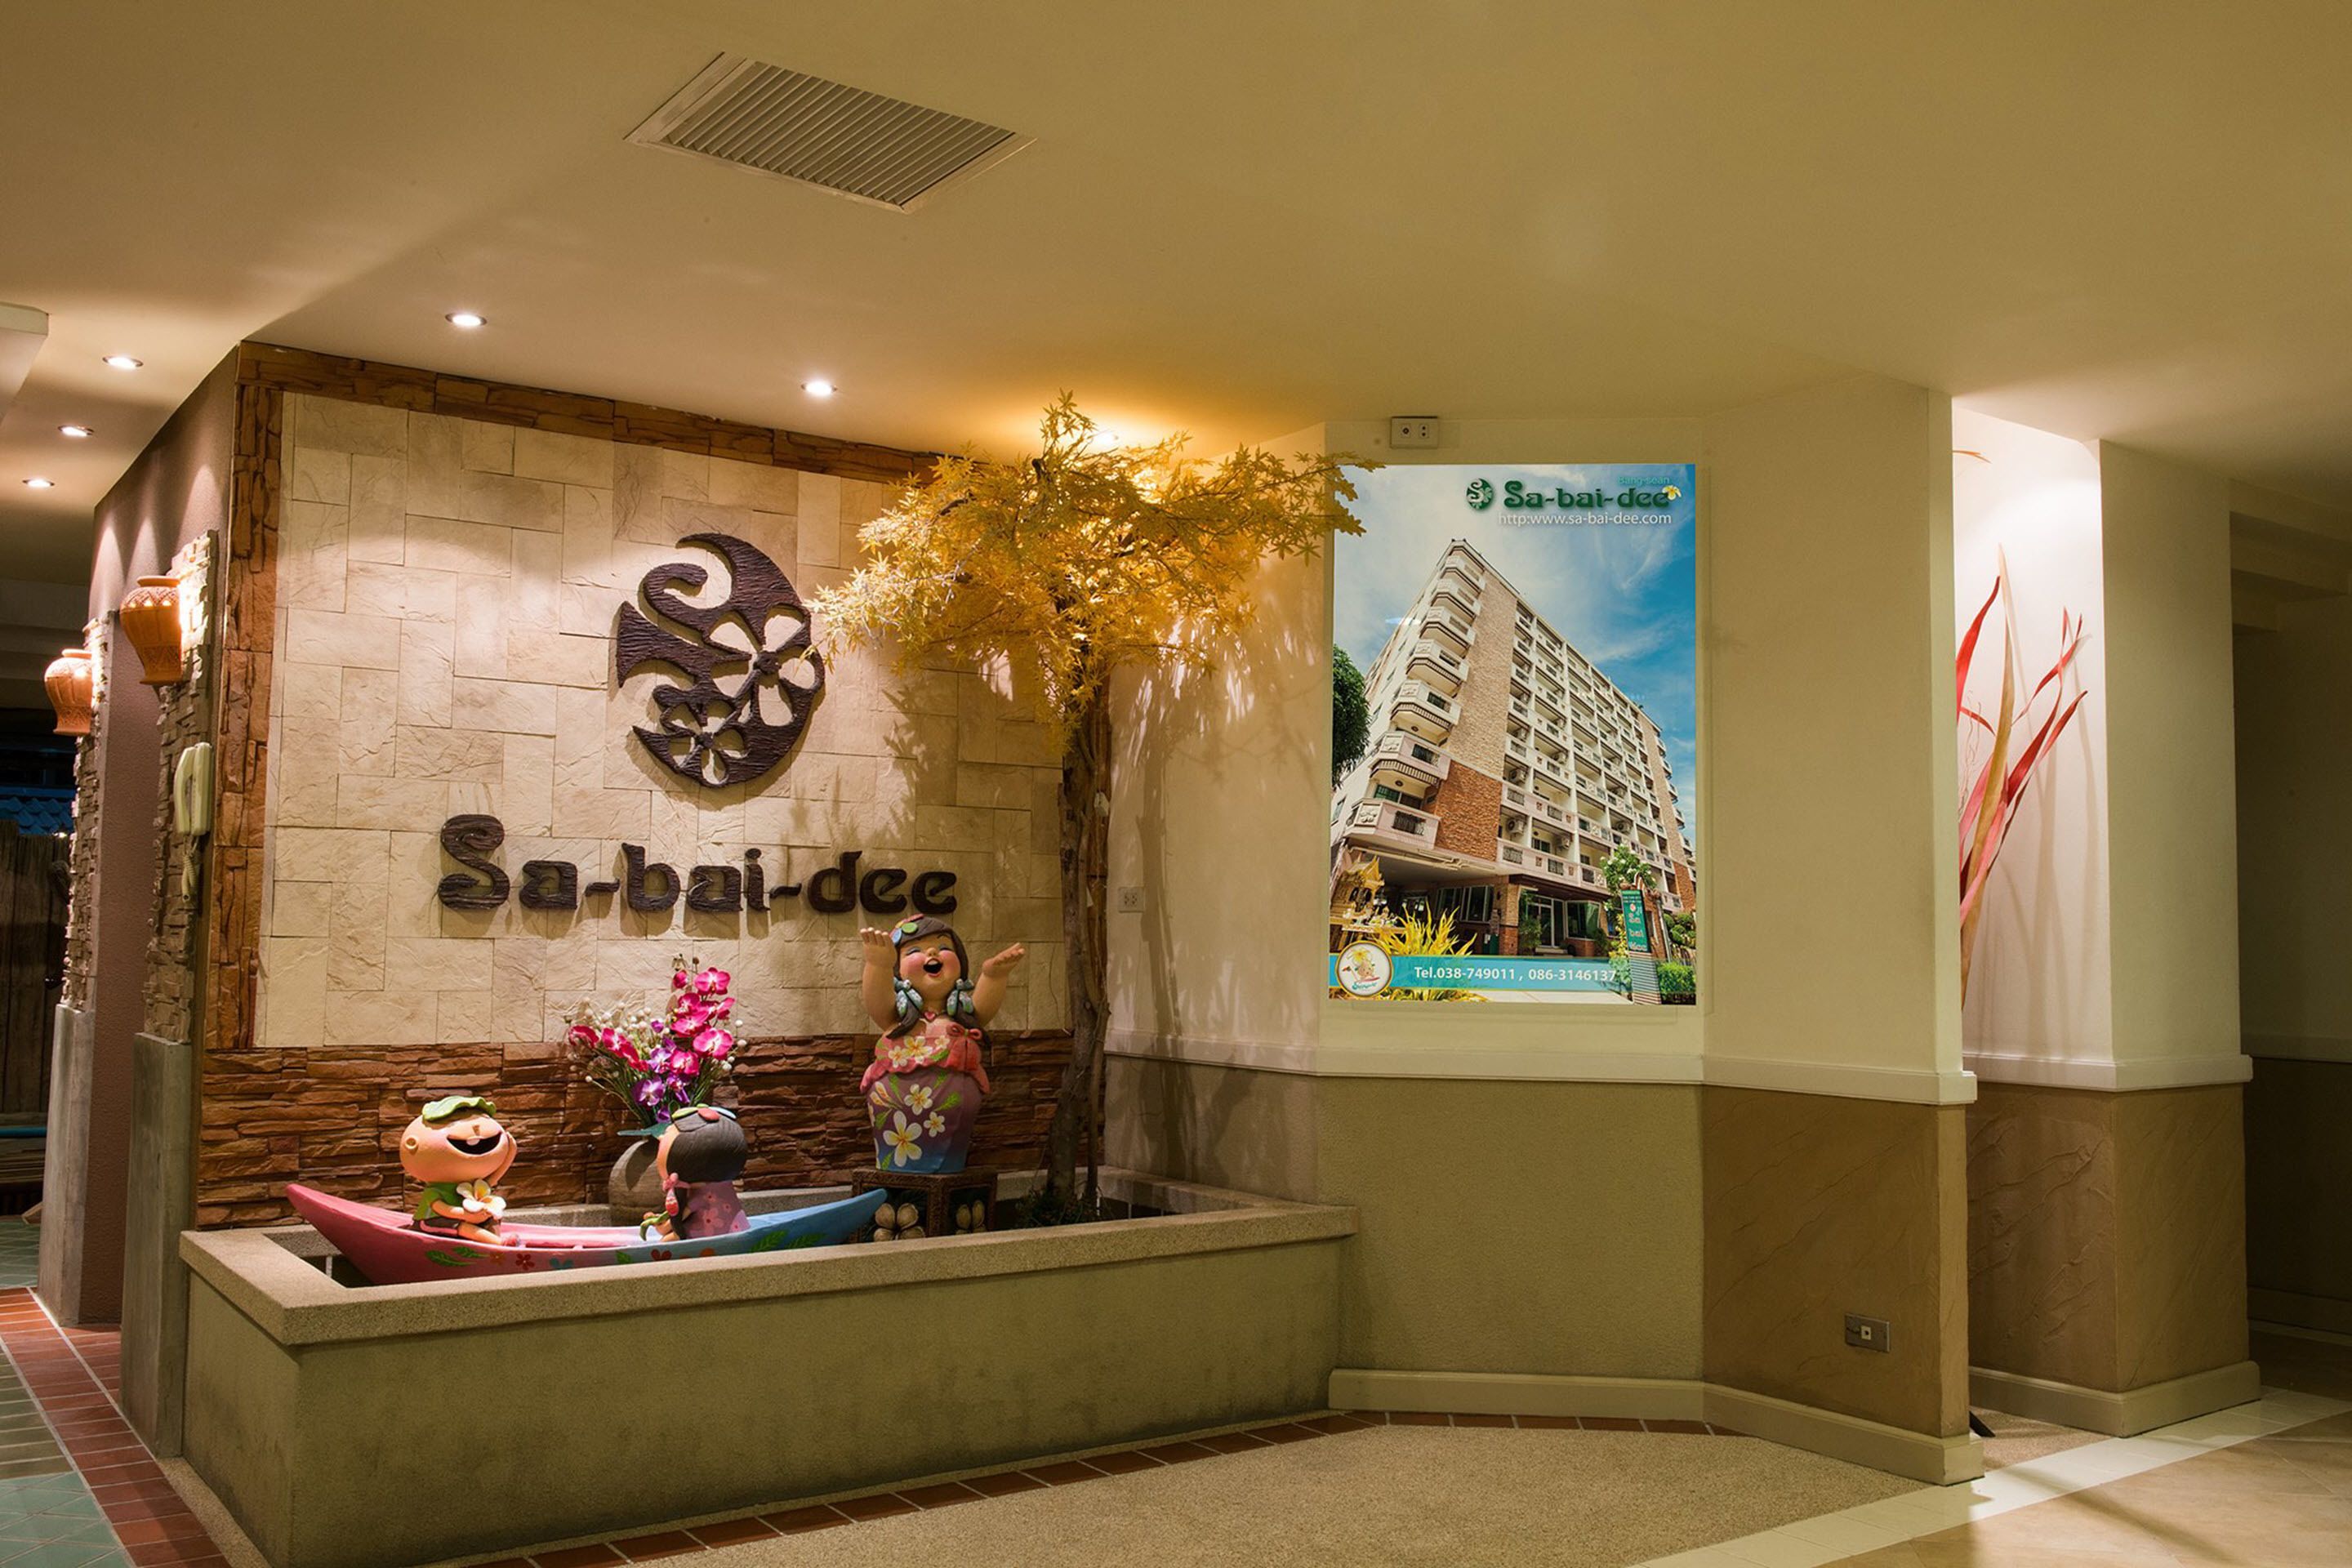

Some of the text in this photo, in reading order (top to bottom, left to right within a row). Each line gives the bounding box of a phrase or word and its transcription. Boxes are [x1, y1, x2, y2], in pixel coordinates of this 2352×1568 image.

[1503, 480, 1670, 508] Sa-bai-dee
[1498, 512, 1672, 526] http:www.sa-bai-dee.com
[438, 814, 957, 913] Sa-bai-dee
[1528, 969, 1616, 981] 086-3146137
